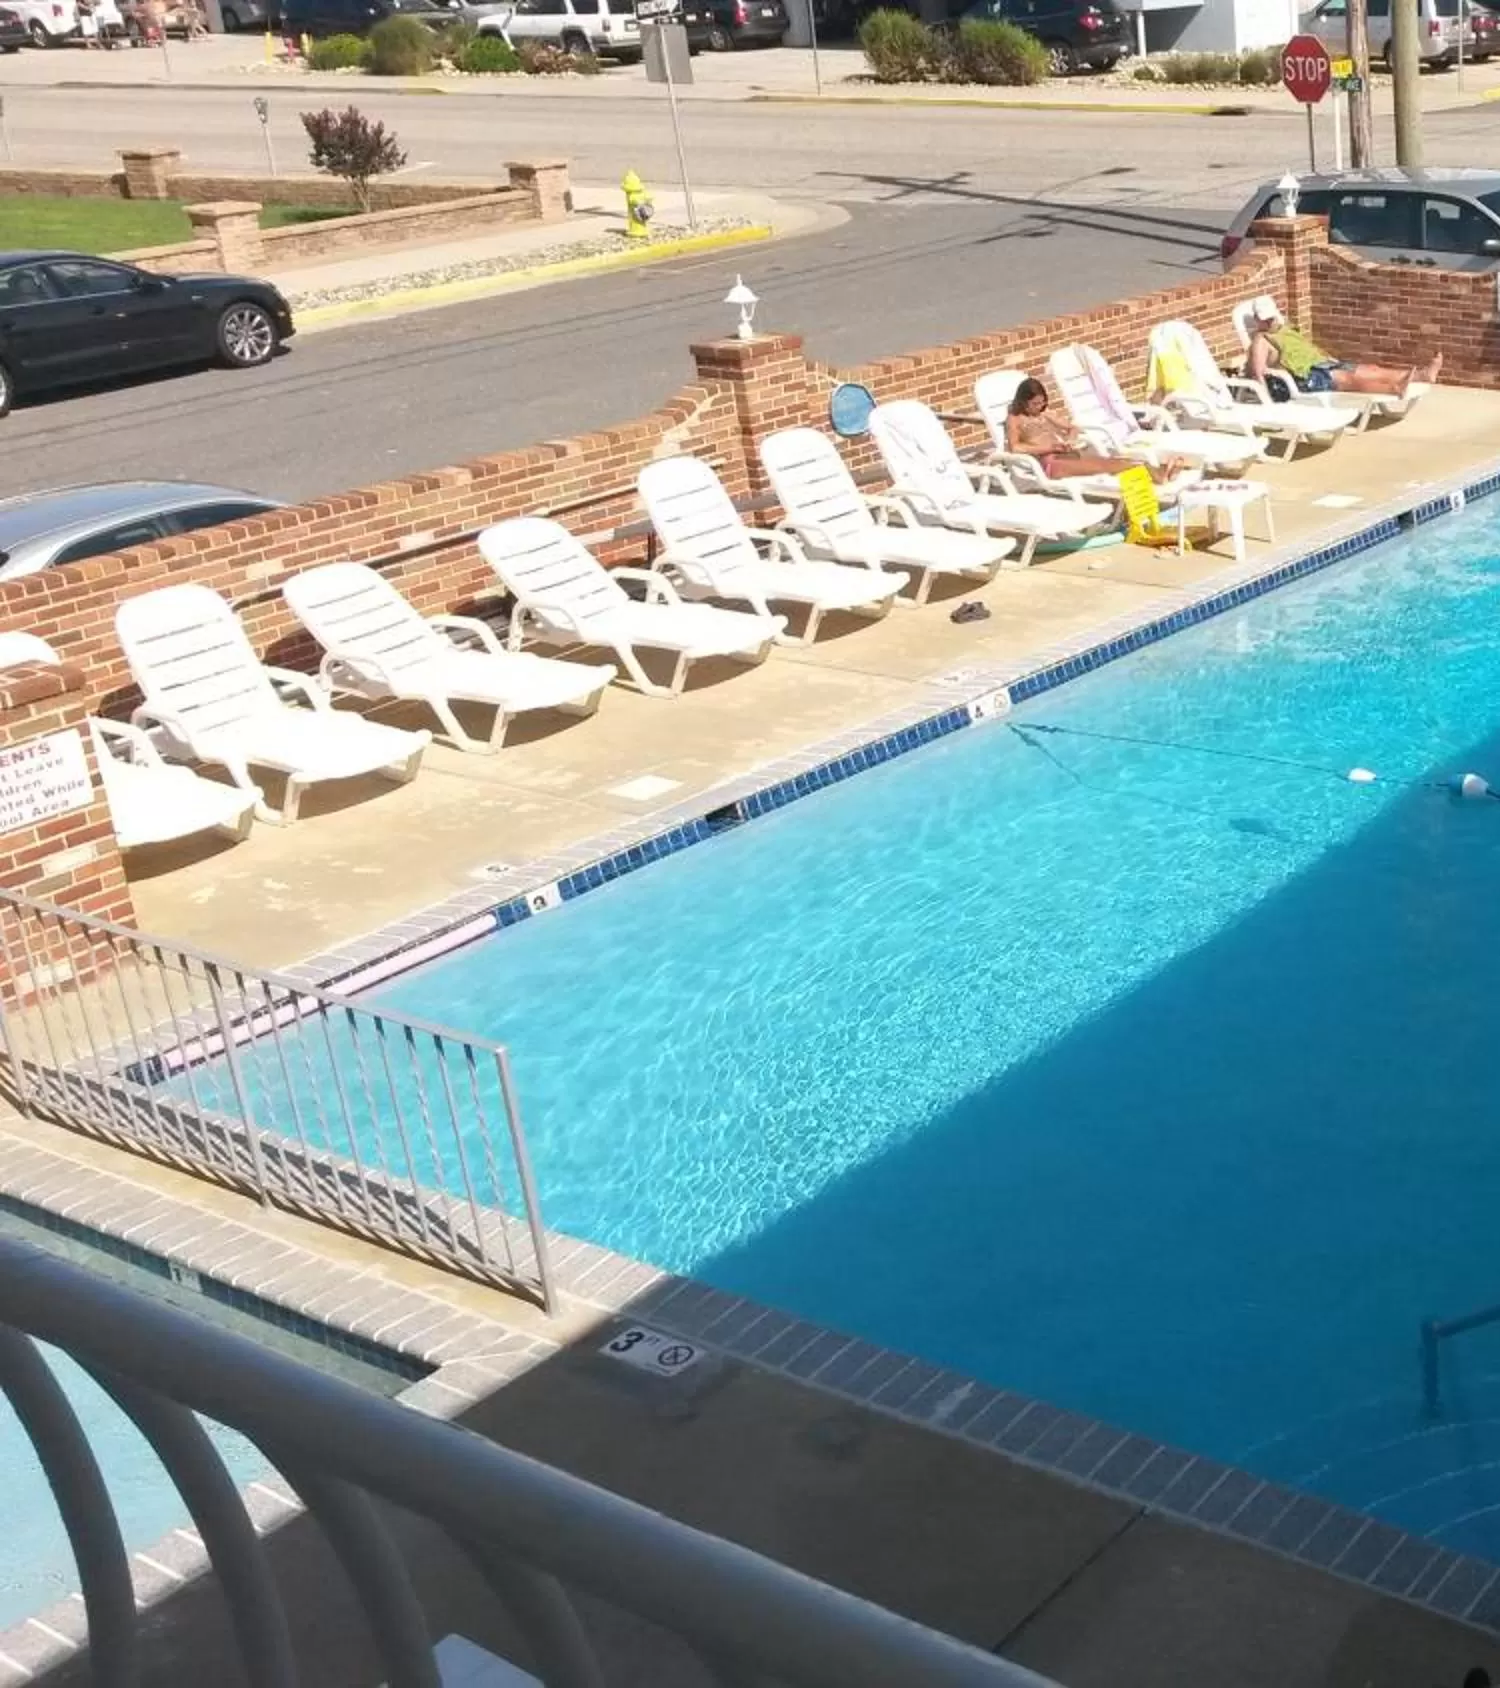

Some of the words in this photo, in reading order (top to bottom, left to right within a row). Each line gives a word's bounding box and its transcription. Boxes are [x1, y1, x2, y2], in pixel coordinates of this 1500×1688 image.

[1285, 57, 1328, 81] STOP
[42, 779, 85, 798] While
[32, 799, 69, 817] Area
[609, 1331, 645, 1352] 3
